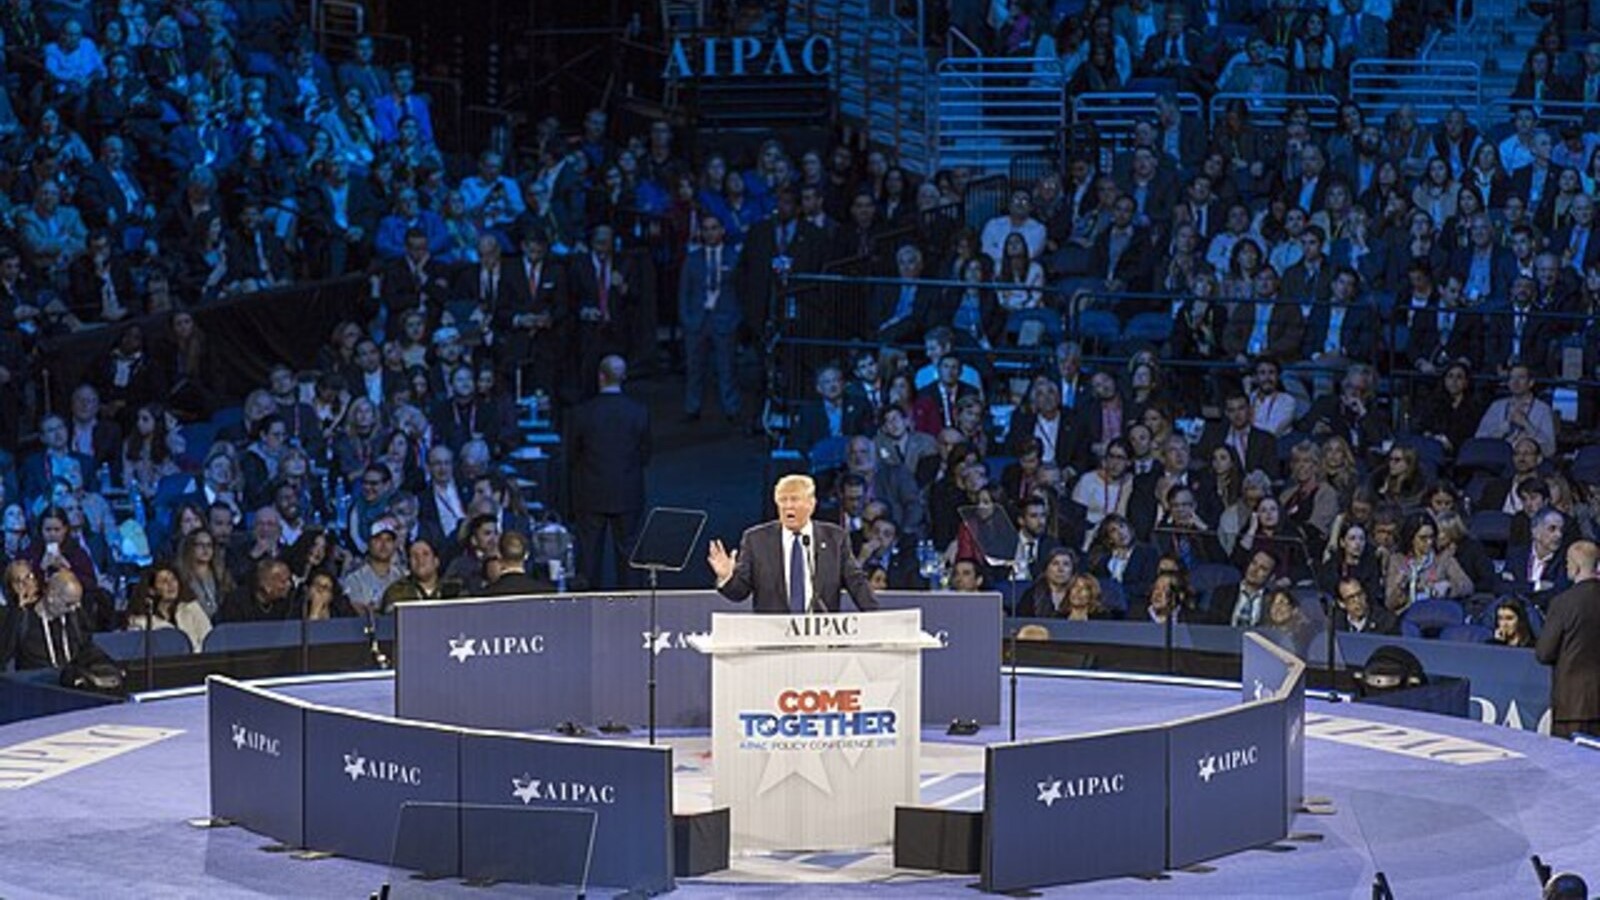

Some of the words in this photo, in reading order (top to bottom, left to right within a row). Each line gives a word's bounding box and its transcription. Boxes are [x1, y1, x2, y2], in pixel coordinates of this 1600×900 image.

[663, 35, 833, 78] AIPAC
[785, 617, 859, 637] AIPAC
[477, 634, 545, 657] AIPAC
[778, 689, 862, 714] COME
[738, 709, 897, 738] TOGETHER
[244, 731, 281, 757] AIPAC
[772, 739, 807, 750] POLICY
[809, 739, 873, 750] CONFERENCE
[1216, 745, 1258, 773] AIPAC
[365, 759, 422, 786] AIPAC
[544, 782, 615, 804] AIPAC
[1064, 773, 1125, 798] AIPAC
